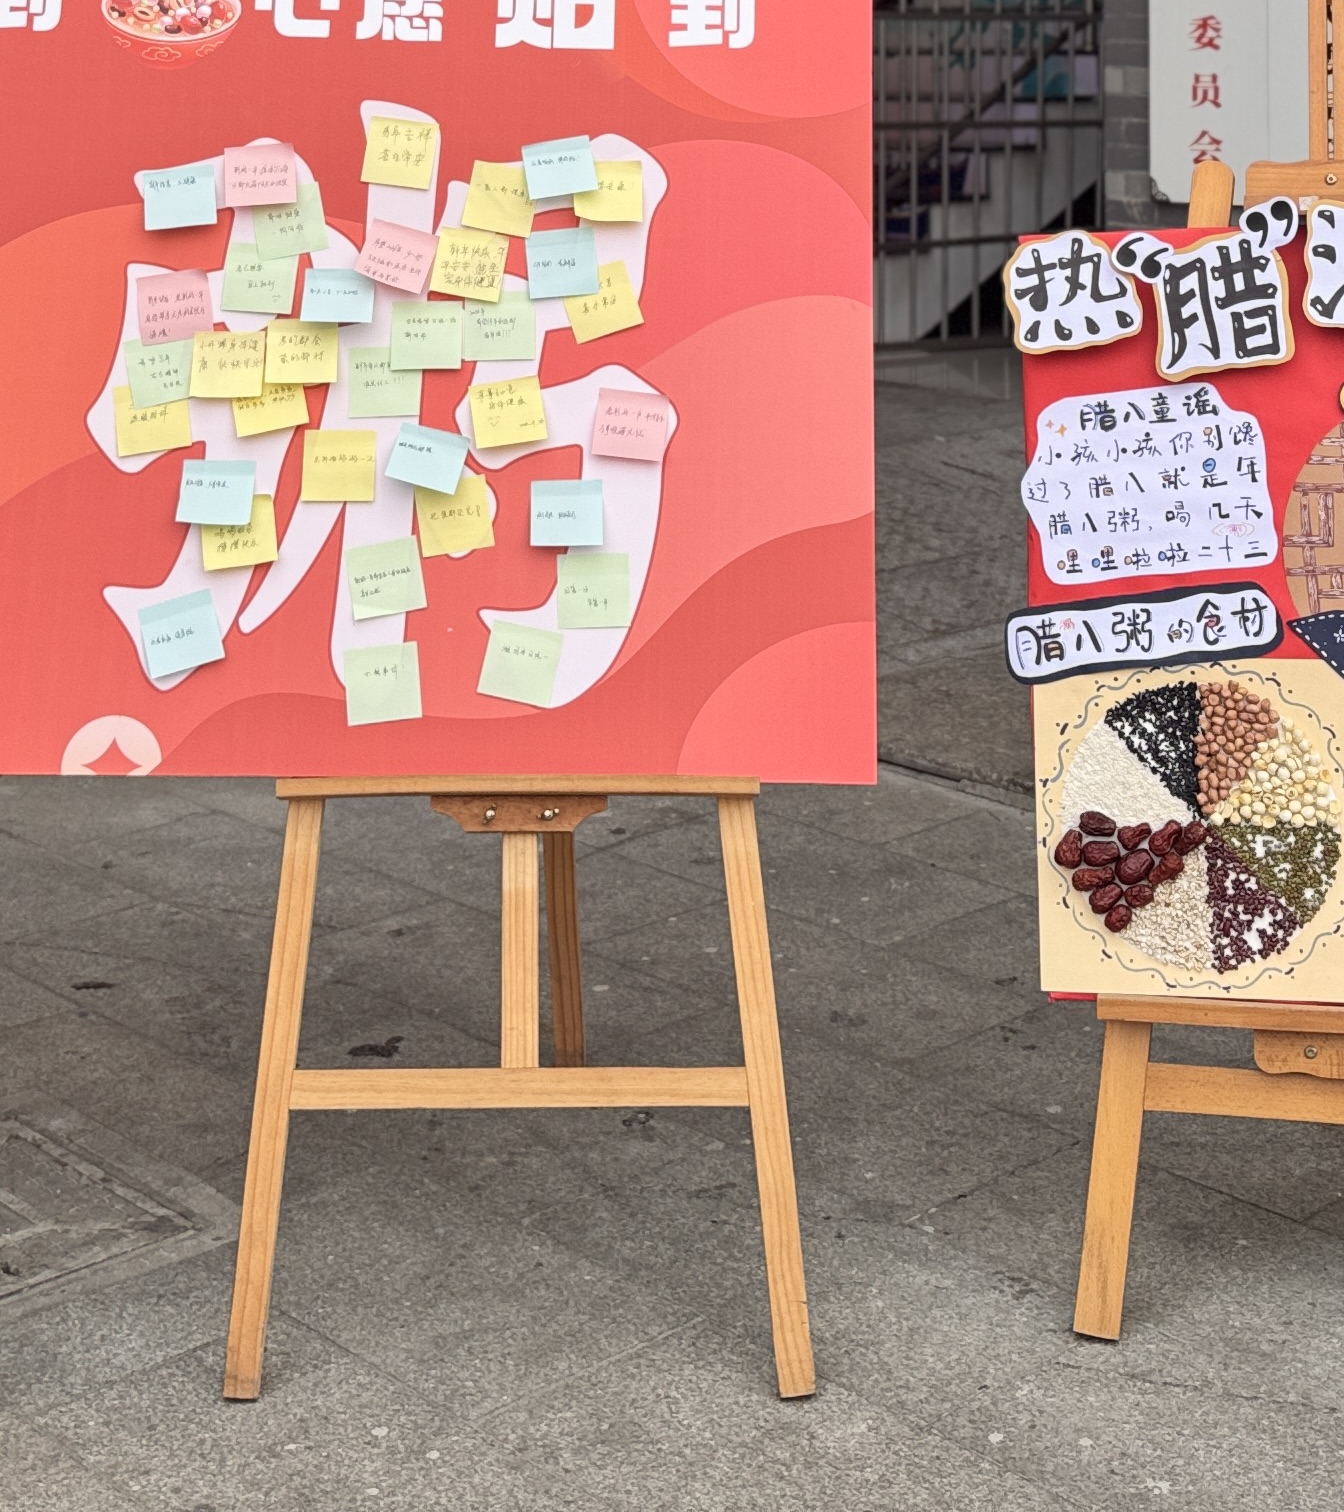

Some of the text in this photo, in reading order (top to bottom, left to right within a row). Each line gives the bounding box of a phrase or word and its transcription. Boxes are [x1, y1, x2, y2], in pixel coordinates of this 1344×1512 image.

[1078, 387, 1221, 432] 腊八童谣
[1037, 422, 1259, 467] 小孩小孩你别馋
[1026, 456, 1262, 502] 过了腊八就是年
[1056, 537, 1269, 576] 哩哩啦啦二十三
[1015, 597, 1268, 664] 腊八粥的食材
